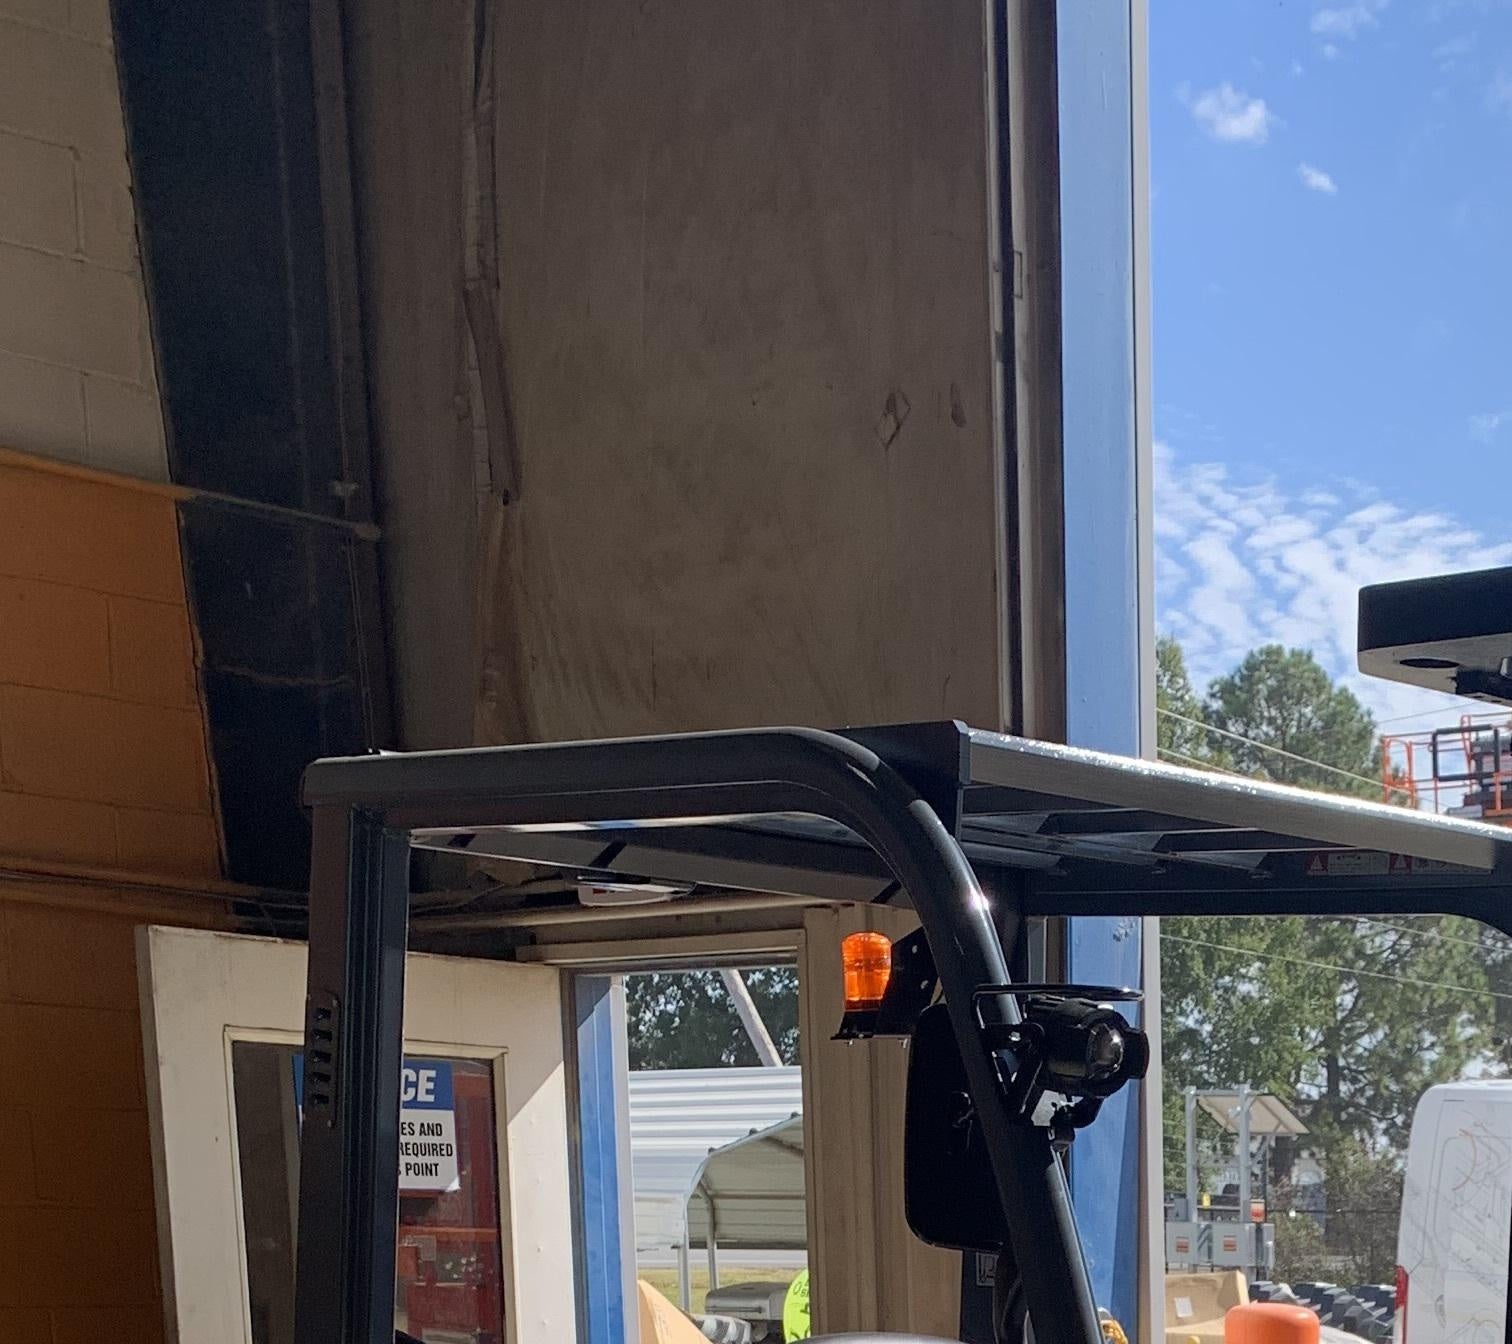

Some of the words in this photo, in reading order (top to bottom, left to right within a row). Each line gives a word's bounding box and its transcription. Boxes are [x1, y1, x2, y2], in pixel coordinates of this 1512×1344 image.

[401, 1067, 437, 1102] CE
[401, 1122, 415, 1136] ES
[420, 1122, 442, 1137] AND
[405, 1162, 439, 1177] POINT
